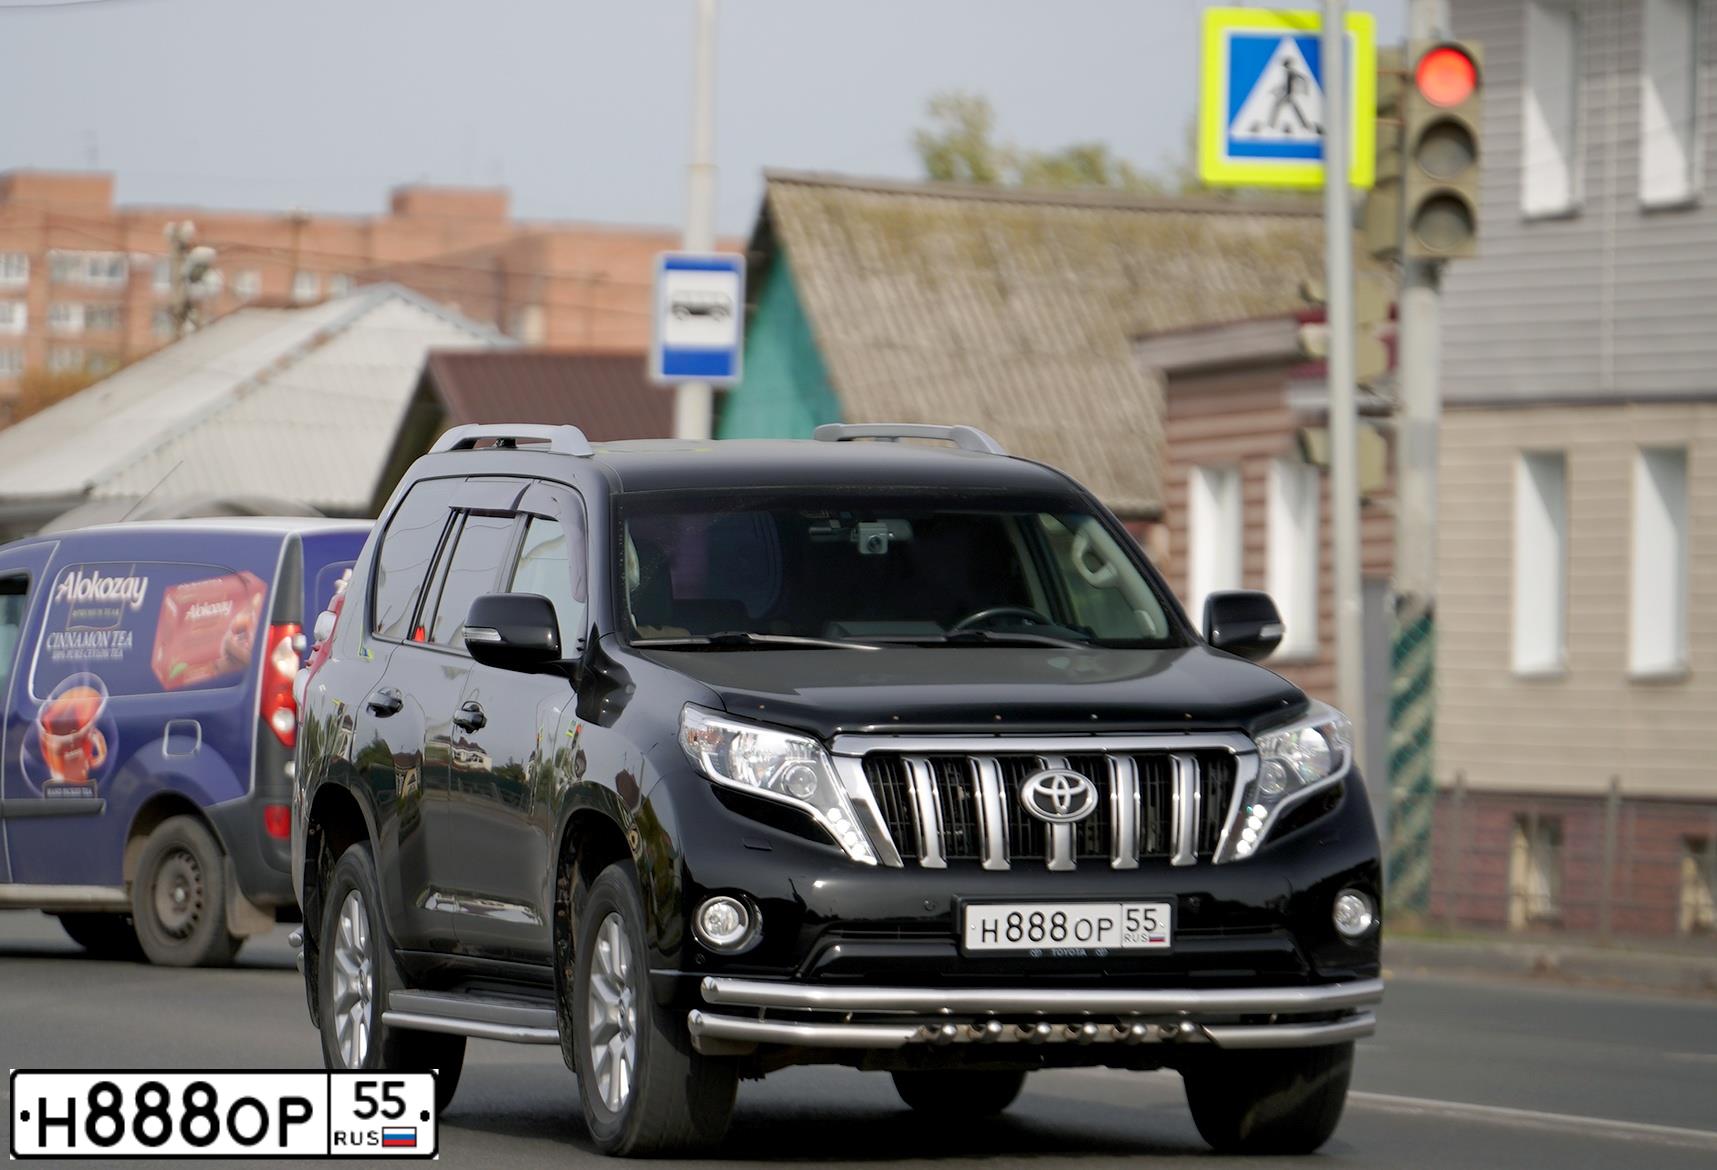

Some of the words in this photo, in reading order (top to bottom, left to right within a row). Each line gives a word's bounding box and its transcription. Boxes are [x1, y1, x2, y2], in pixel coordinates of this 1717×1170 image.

[55, 570, 148, 611] Alokozay
[46, 631, 110, 652] CINNAMON
[110, 630, 133, 650] TEA
[1126, 908, 1158, 932] 55
[1123, 933, 1148, 943] RUS
[1051, 947, 1088, 957] TOYOTA
